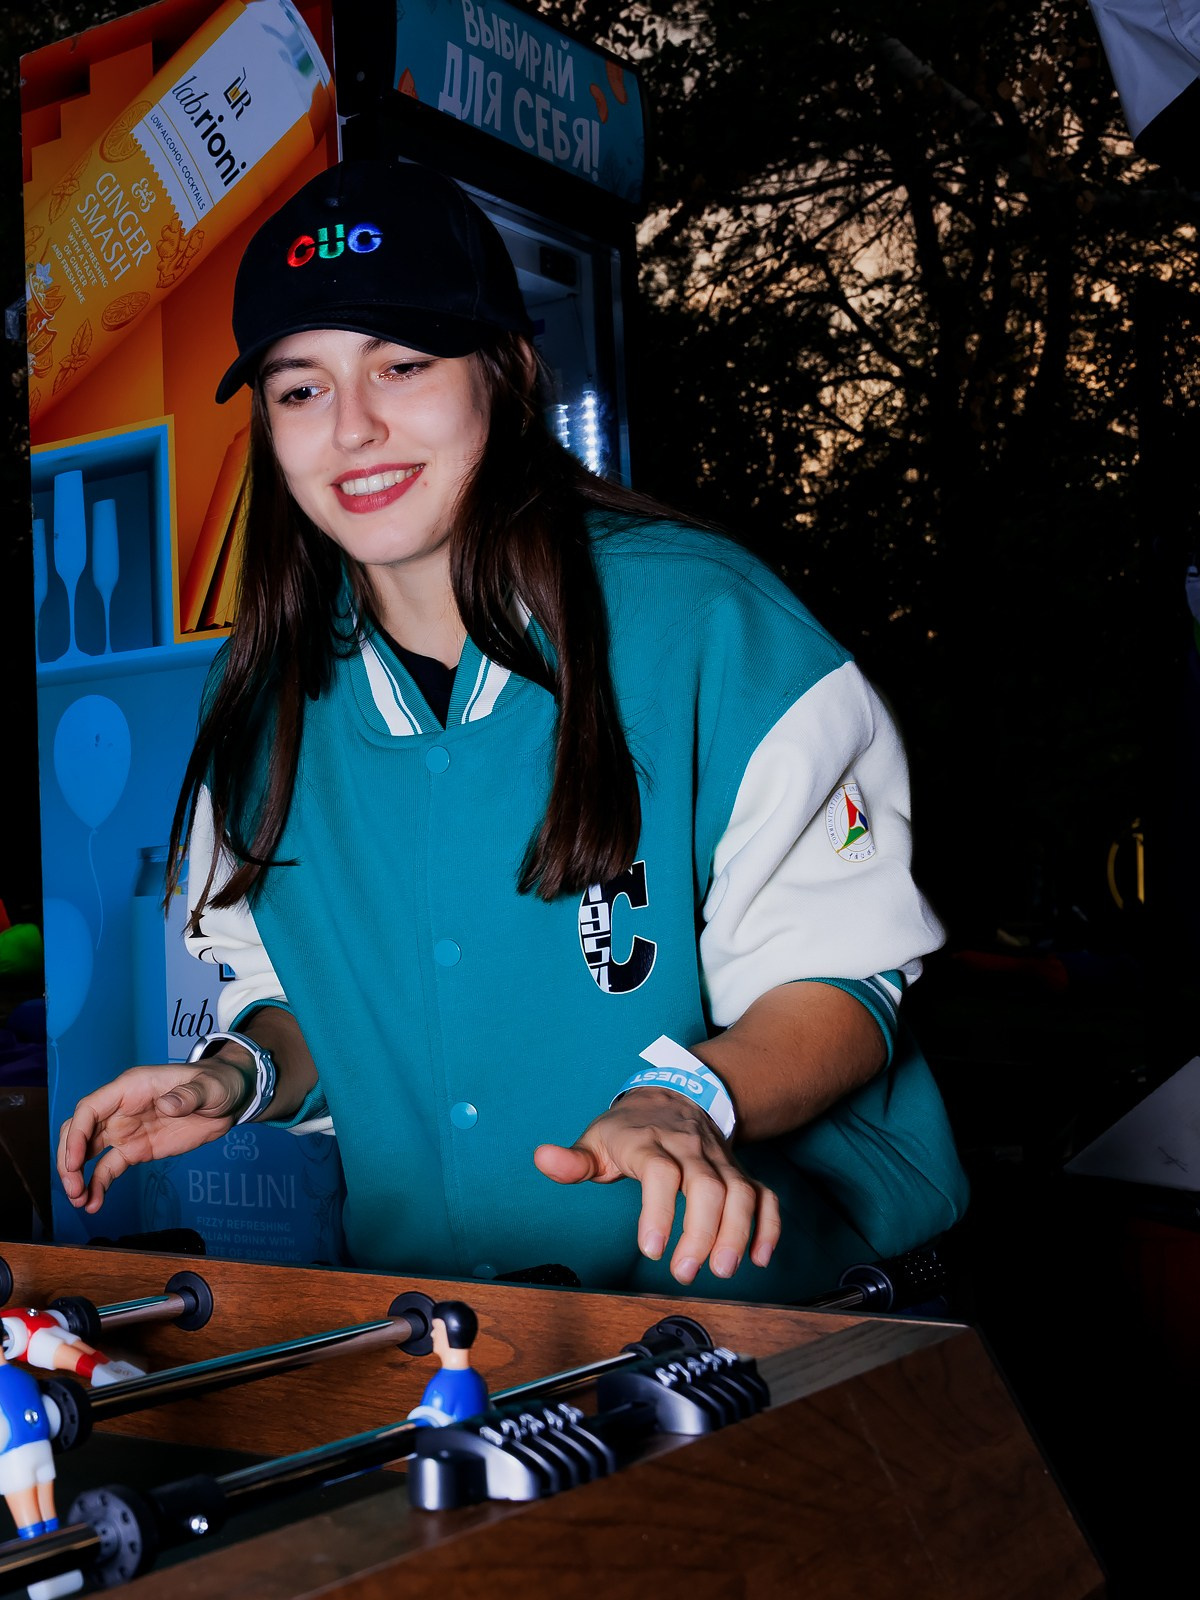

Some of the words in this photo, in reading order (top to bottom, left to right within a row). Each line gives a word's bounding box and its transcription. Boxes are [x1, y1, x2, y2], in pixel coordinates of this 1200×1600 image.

[461, 0, 575, 102] ВЫБИРАЙ
[438, 41, 503, 132] ДЛЯ
[513, 87, 600, 182] СЕБЯ!
[181, 165, 205, 211] COCKTAILS
[76, 193, 132, 281] SMASH
[96, 172, 152, 268] GINGER
[63, 245, 72, 256] OF
[69, 256, 88, 288] GINGER
[67, 232, 81, 254] WITH
[78, 253, 85, 262] A
[82, 259, 97, 286] TASTE
[70, 217, 84, 238] FIZZY
[81, 238, 109, 288] REFRESHING
[287, 222, 383, 267] CUC
[51, 243, 63, 260] AND
[61, 258, 76, 285] FRESH
[73, 283, 86, 305] LIME
[630, 1071, 704, 1095] GUEST
[188, 1169, 296, 1209] BELLINI
[196, 1216, 225, 1228] FIZZY
[227, 1219, 291, 1232] REFRESHING
[234, 1234, 267, 1246] DRINK
[269, 1236, 296, 1248] WITH
[228, 1247, 244, 1258] OF
